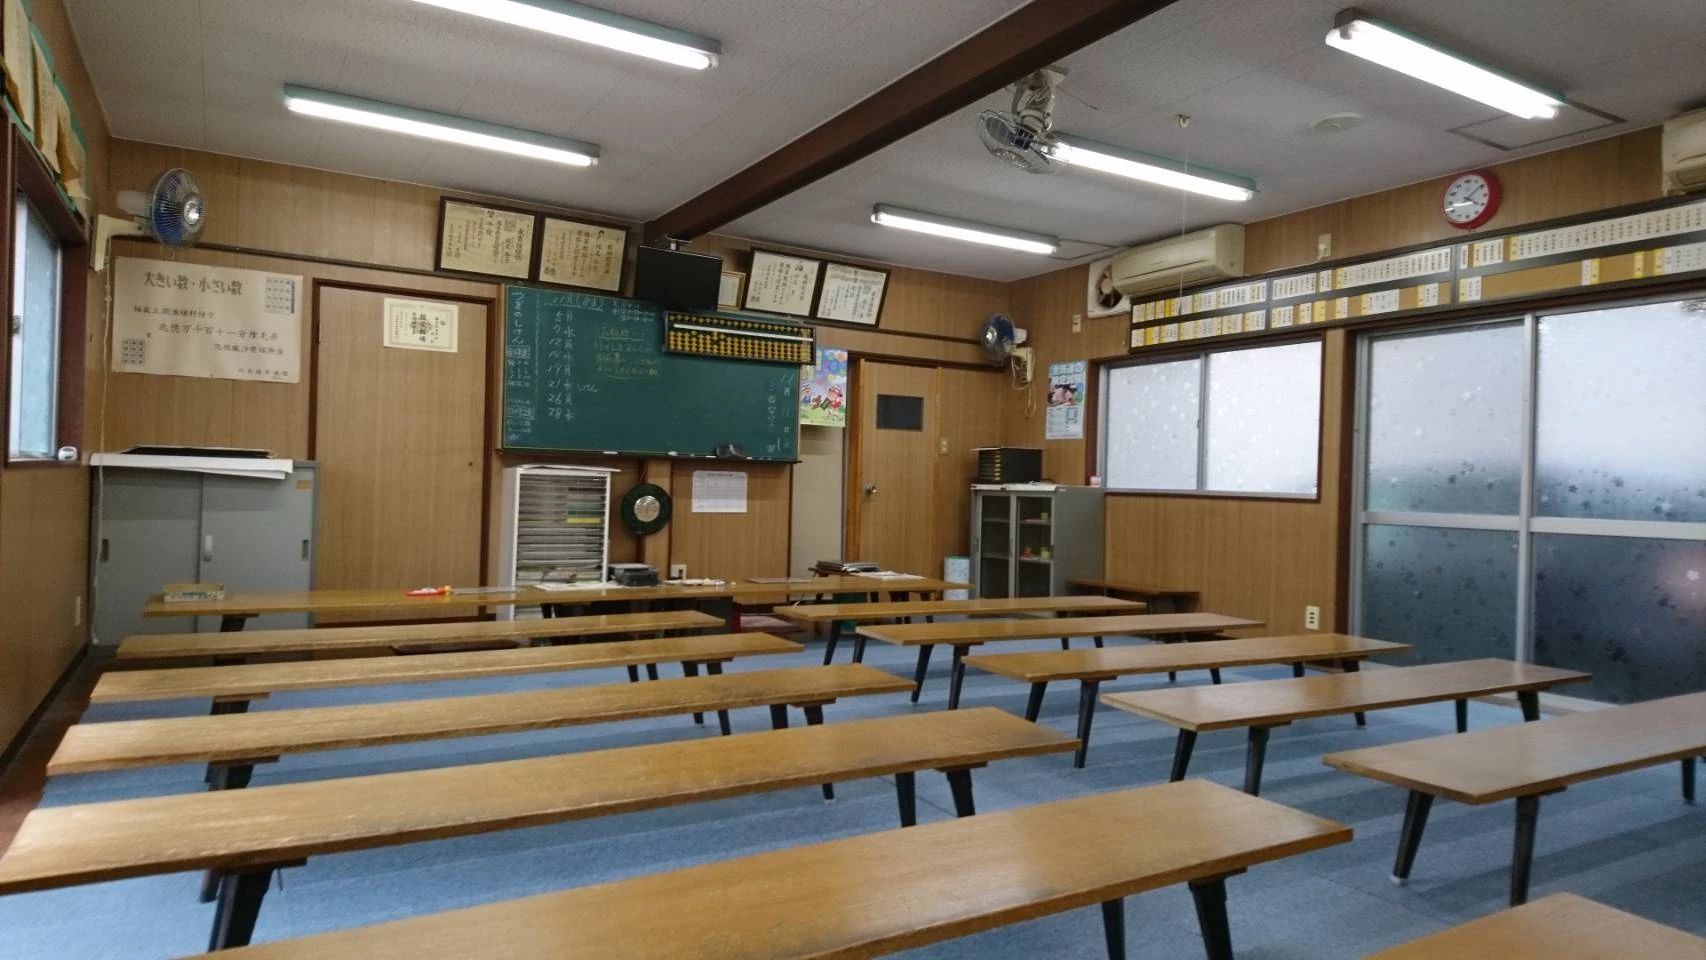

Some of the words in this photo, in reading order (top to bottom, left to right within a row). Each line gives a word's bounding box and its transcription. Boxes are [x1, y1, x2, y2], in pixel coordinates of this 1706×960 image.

[144, 271, 243, 296] 大きい数・小さい数
